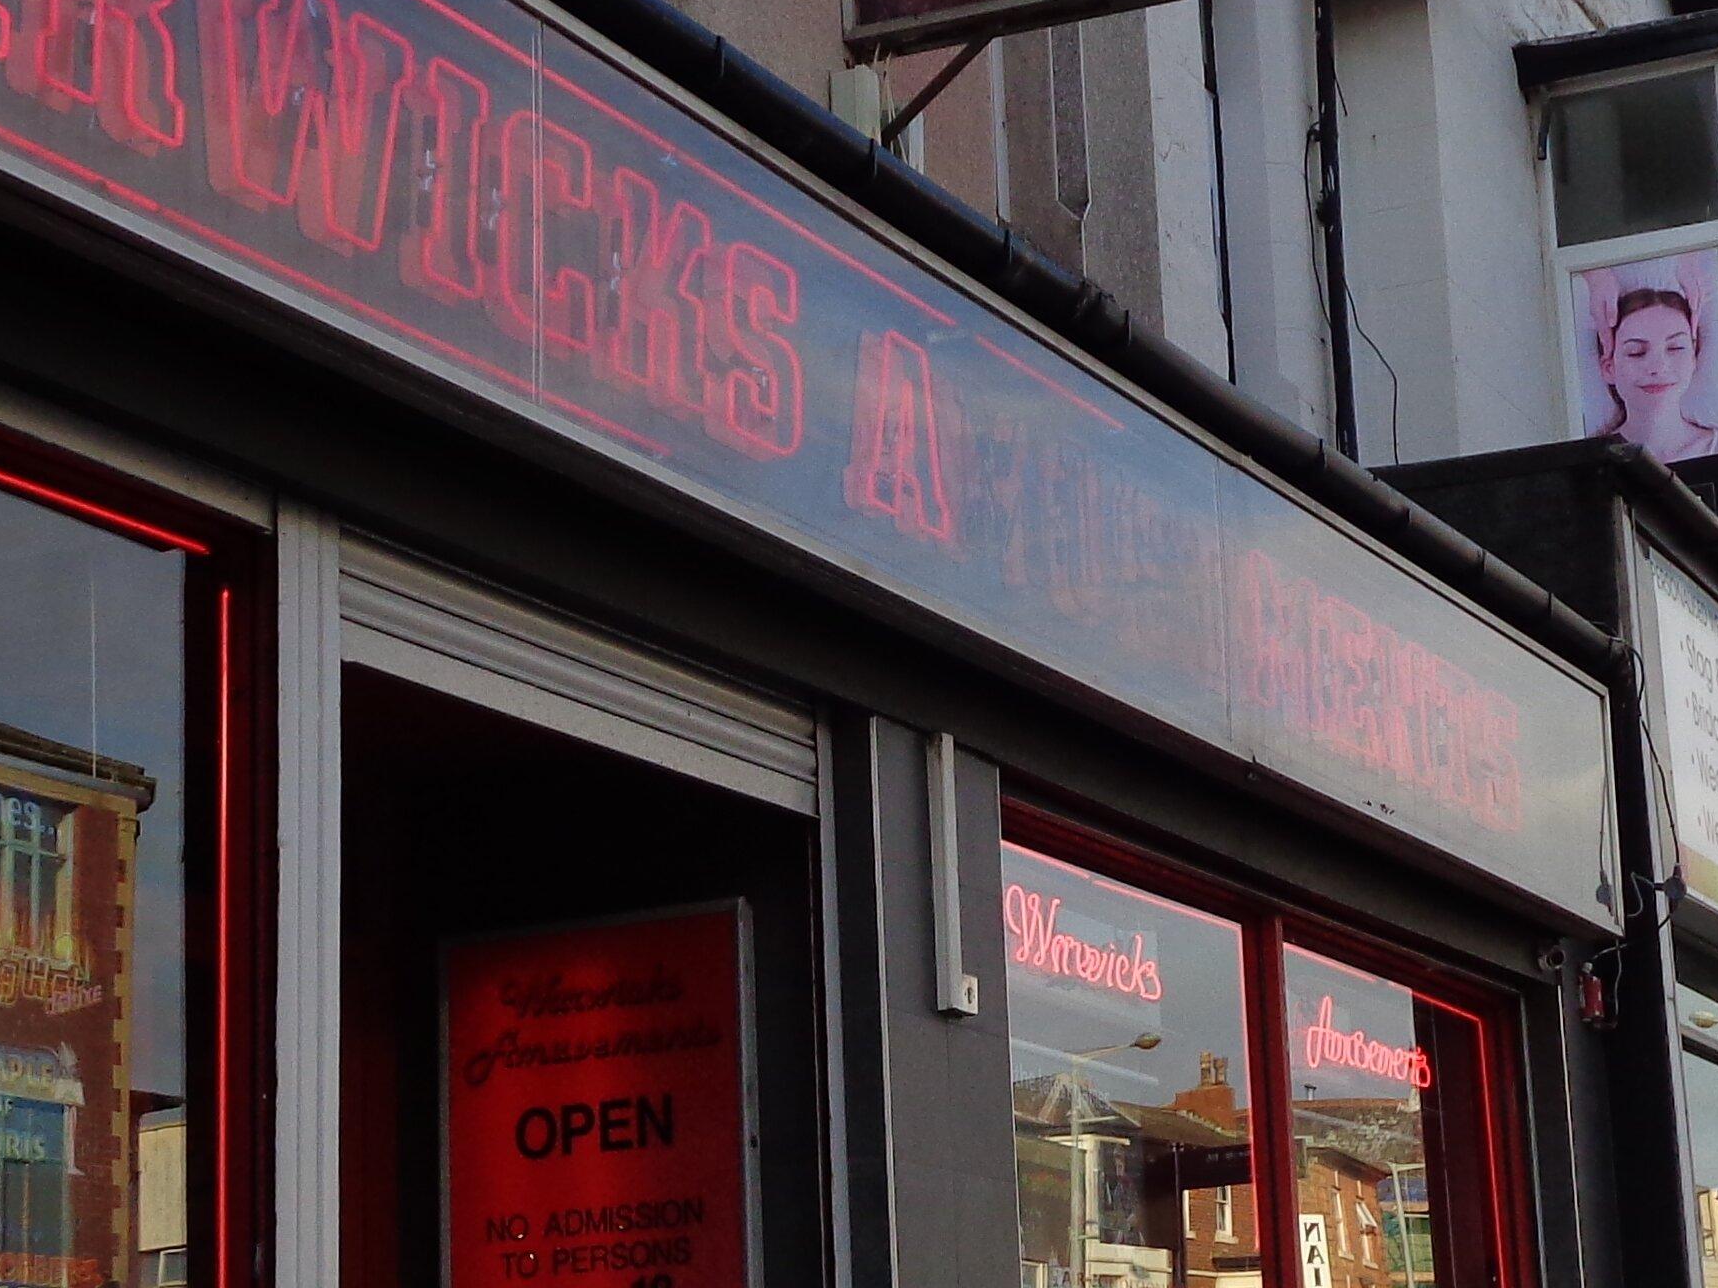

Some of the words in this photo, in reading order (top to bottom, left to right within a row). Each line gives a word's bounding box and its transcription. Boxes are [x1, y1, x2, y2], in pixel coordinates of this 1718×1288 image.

[1685, 633, 1713, 694] Stag
[1005, 884, 1163, 1001] Warwicks
[1306, 994, 1432, 1089] Amusements
[515, 1092, 675, 1160] OPEN
[486, 1214, 530, 1244] NO
[544, 1195, 705, 1240] ADMISSION
[500, 1250, 540, 1280] TO
[551, 1235, 692, 1277] PERSONS
